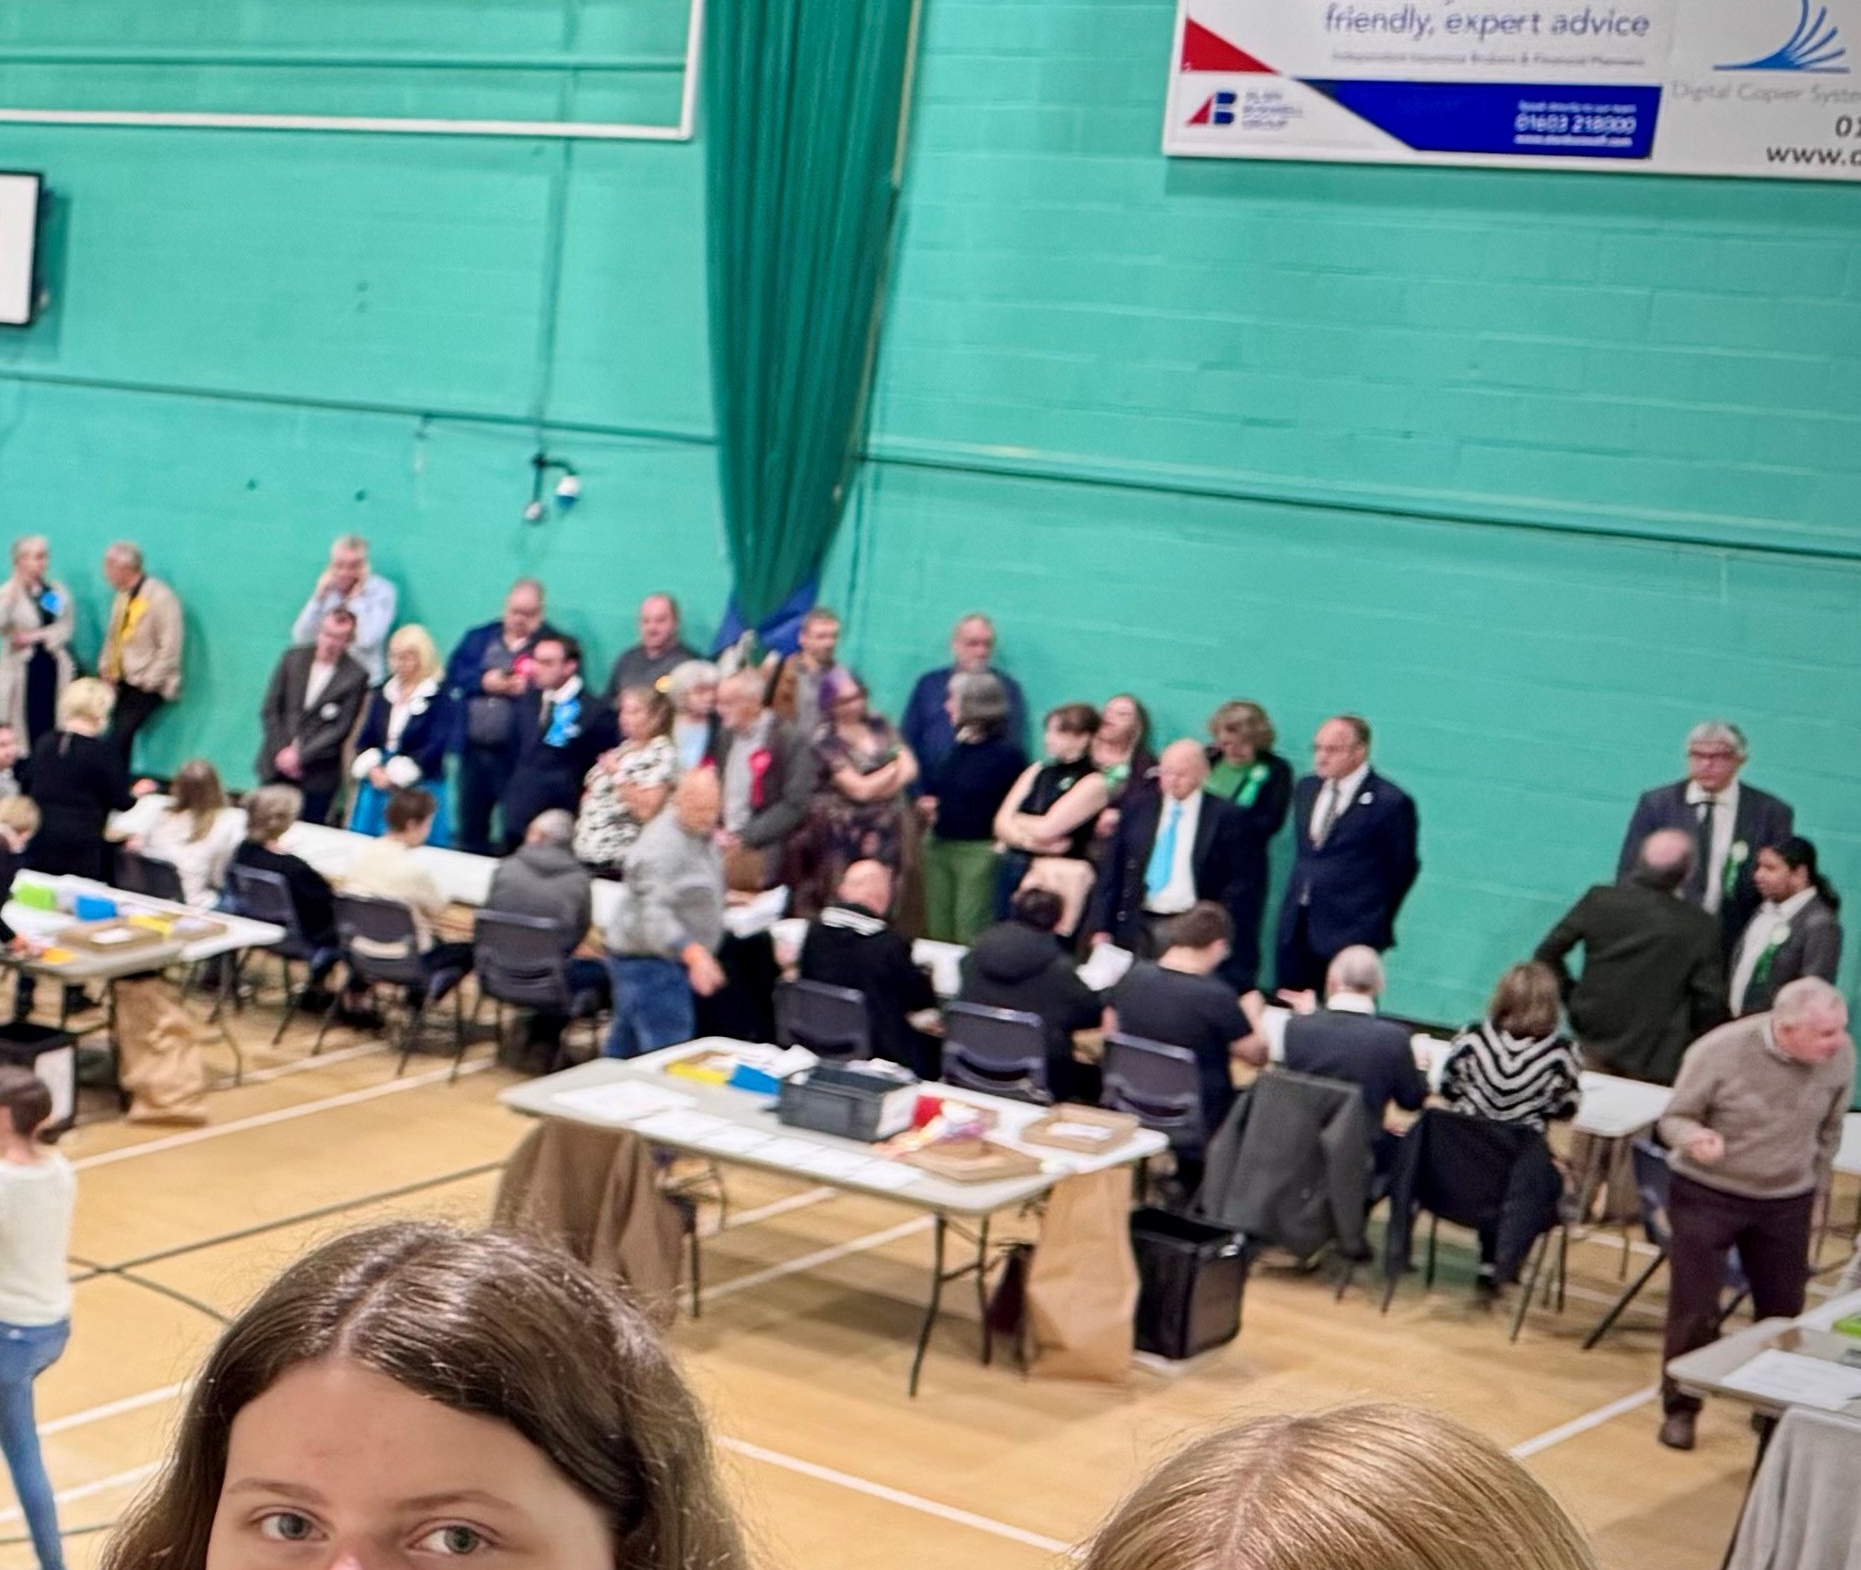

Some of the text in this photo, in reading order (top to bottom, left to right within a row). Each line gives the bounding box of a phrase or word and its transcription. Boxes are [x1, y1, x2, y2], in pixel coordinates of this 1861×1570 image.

[1326, 2, 1651, 41] friendly, expert advice
